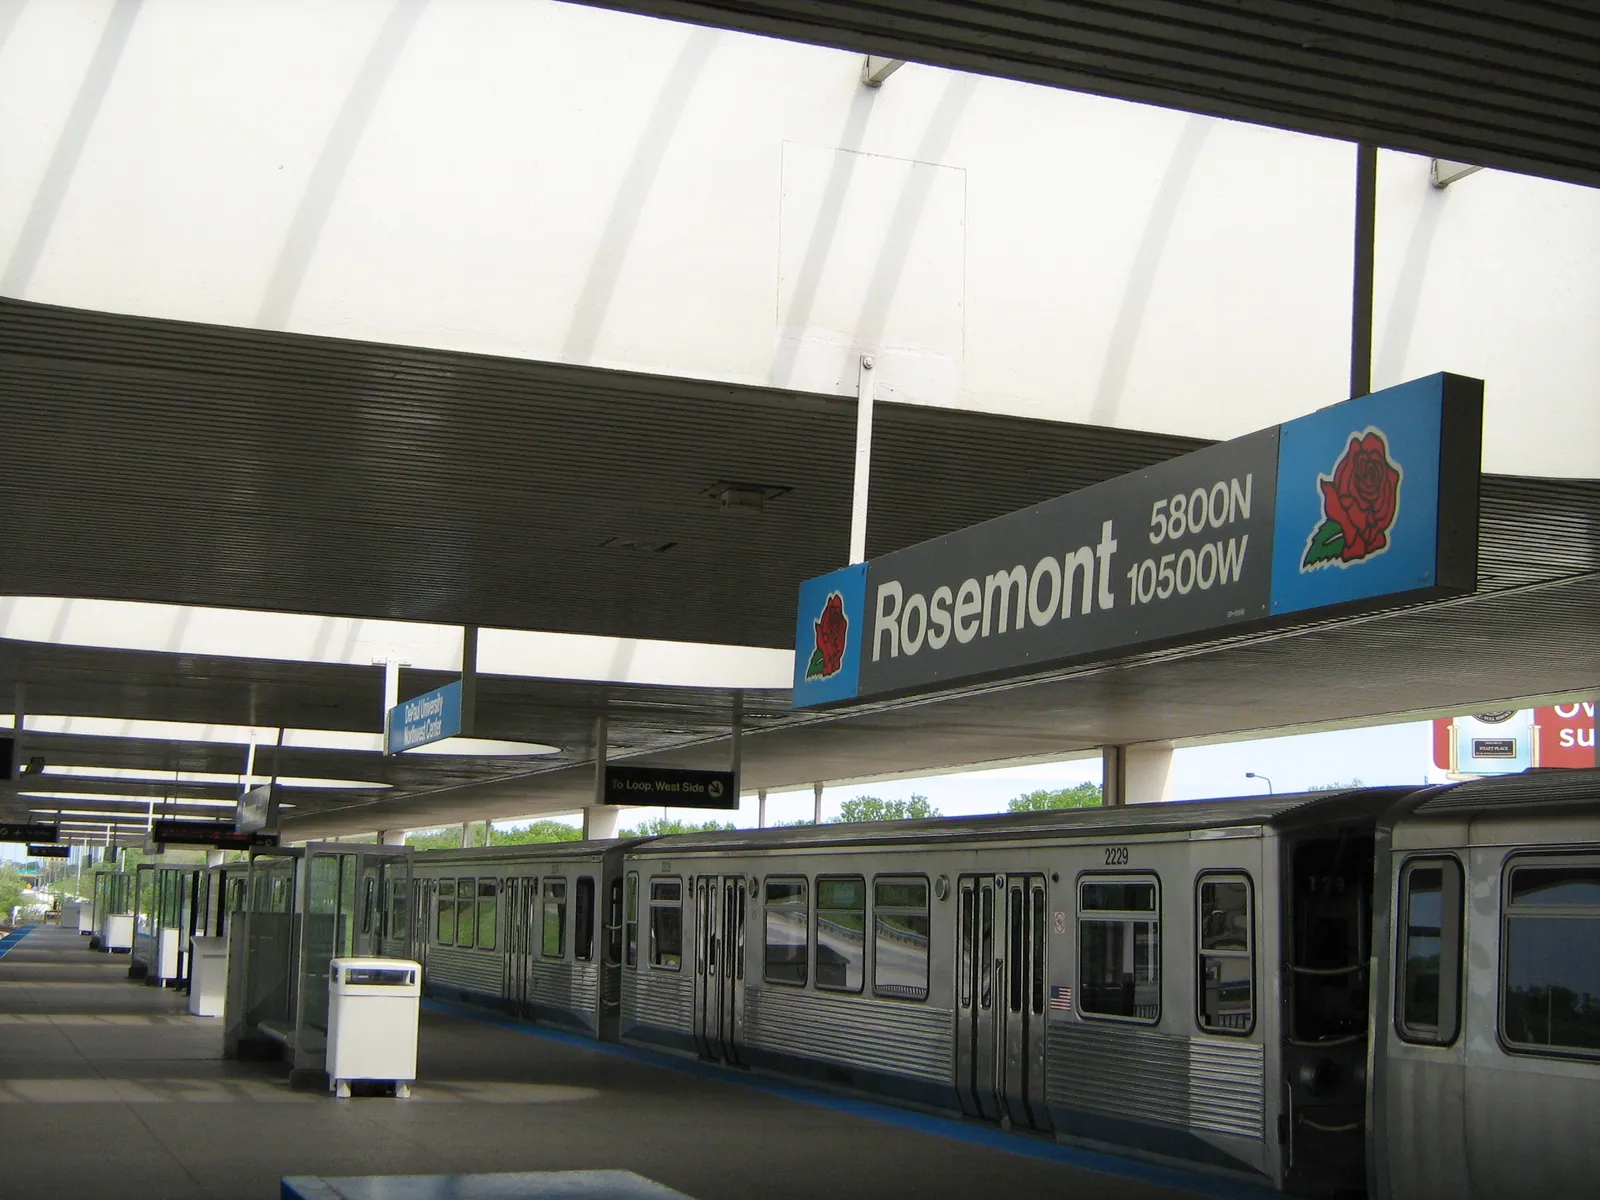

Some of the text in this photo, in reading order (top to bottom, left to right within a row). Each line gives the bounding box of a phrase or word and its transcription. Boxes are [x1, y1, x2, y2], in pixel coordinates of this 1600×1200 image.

[1149, 473, 1253, 545] 5800N
[1126, 534, 1249, 606] 10500W
[872, 520, 1117, 662] Rosemont
[405, 695, 443, 724] DePaul University
[404, 717, 442, 744] Northwest Center
[612, 778, 705, 793] To Loop, West Side
[1105, 847, 1129, 865] 2229
